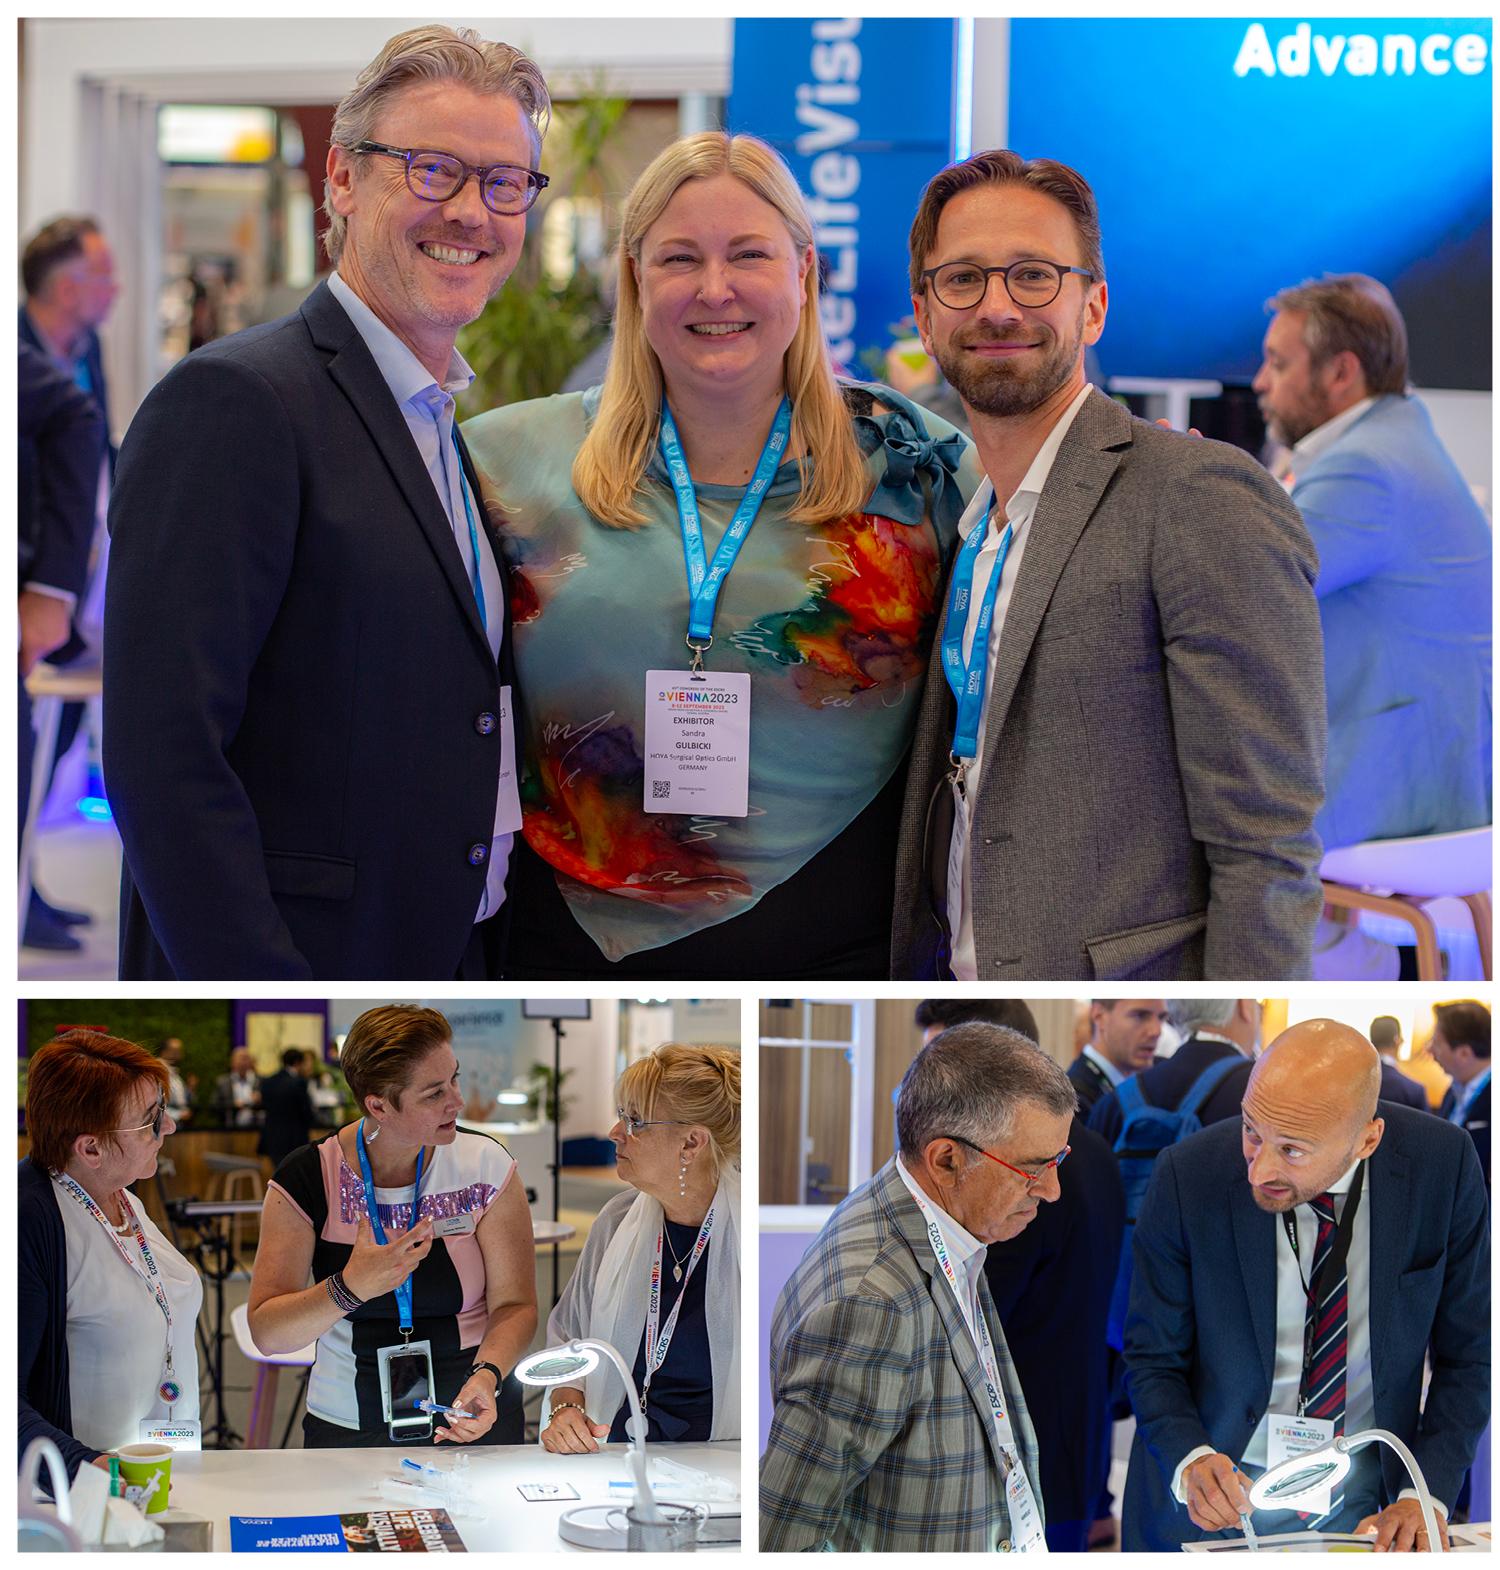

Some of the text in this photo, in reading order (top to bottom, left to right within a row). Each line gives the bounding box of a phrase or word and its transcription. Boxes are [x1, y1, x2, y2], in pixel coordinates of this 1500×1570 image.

[959, 588, 969, 611] HOYA
[979, 604, 989, 629] HOYA
[967, 670, 976, 695] HOYA
[667, 692, 738, 703] VIENNA2023
[673, 717, 714, 725] EXHIBITOR
[675, 742, 711, 750] GULBICKI
[67, 1180, 104, 1224] VIENNA2023
[134, 1227, 158, 1276] VIENNA2023
[928, 1222, 956, 1285] VIENNA2023
[650, 1265, 661, 1314] VIENNA2023
[985, 1382, 1001, 1408] ESCRS
[371, 1511, 402, 1552] VISUALLY
[390, 1511, 413, 1530] LIFE
